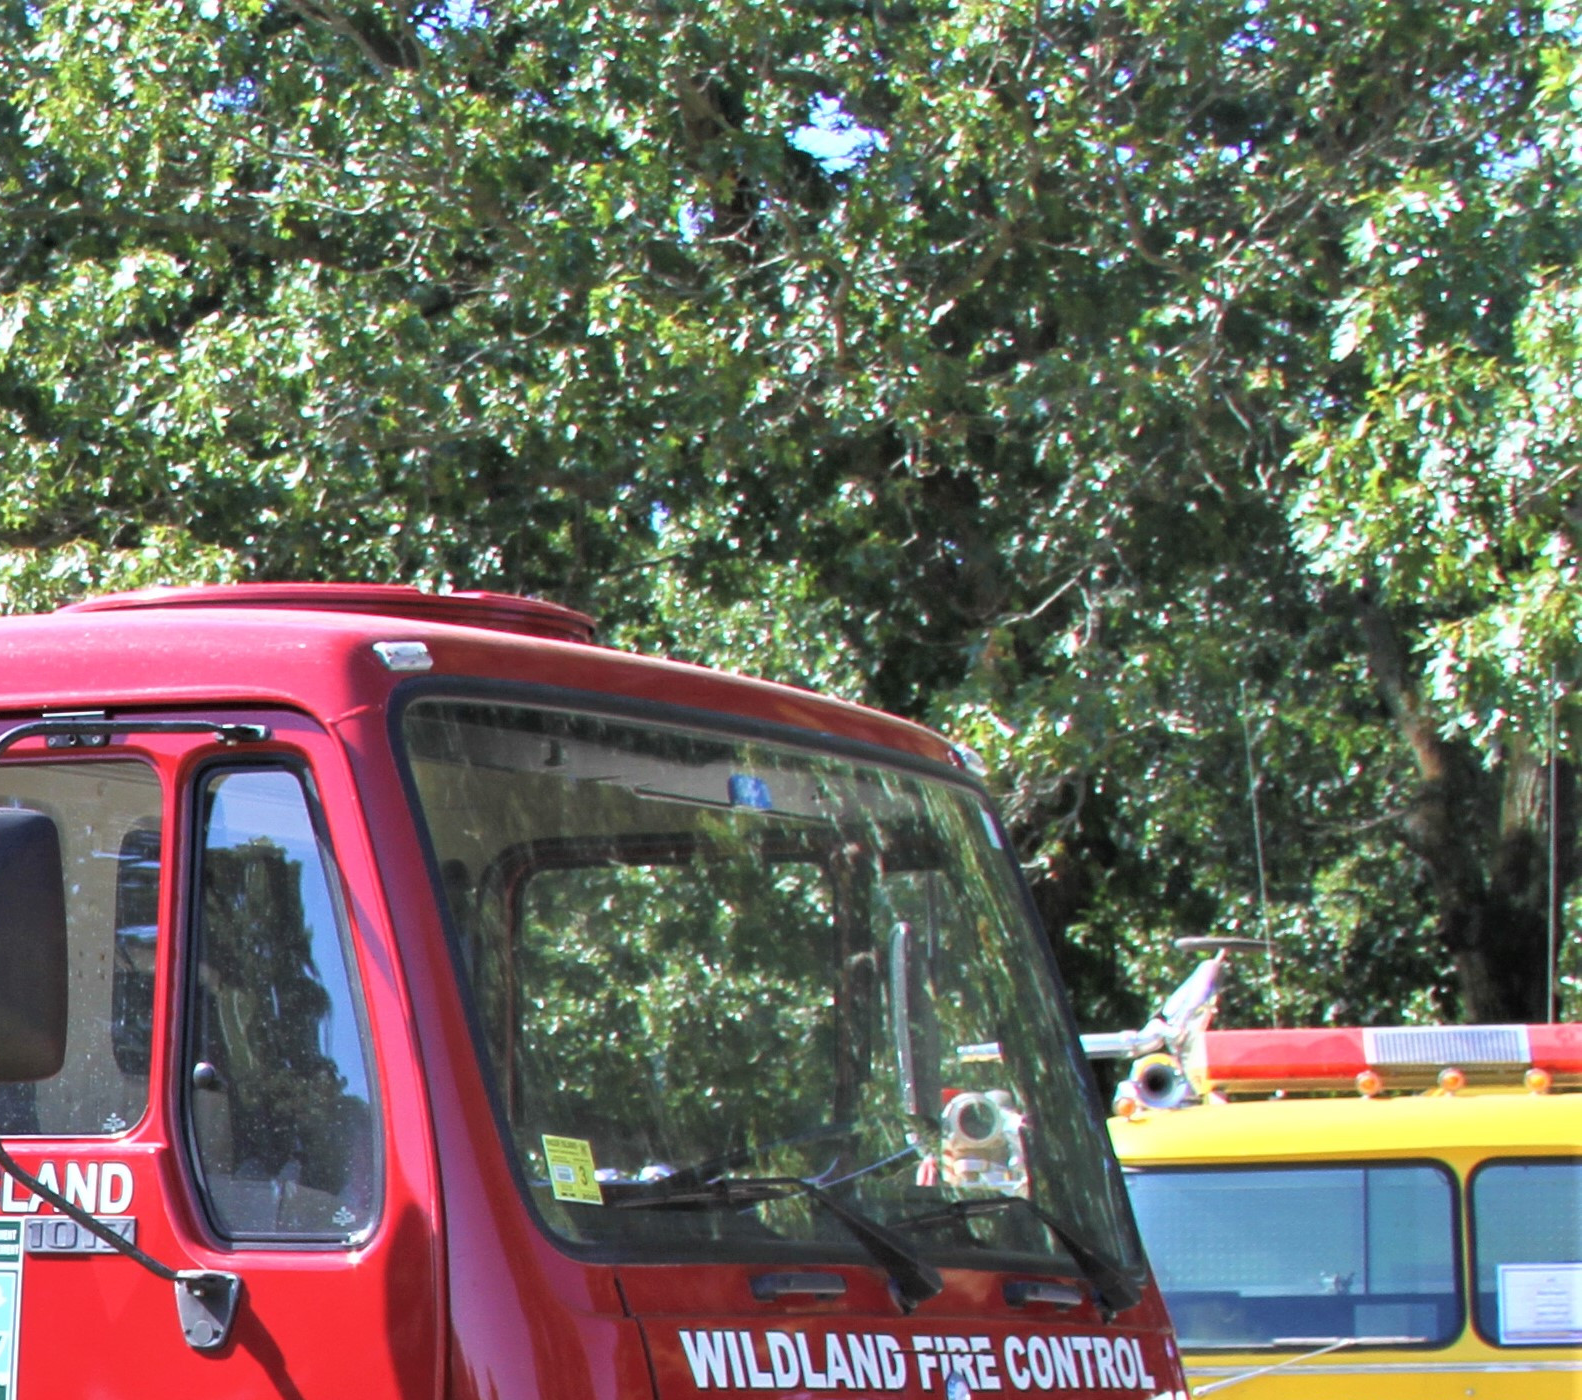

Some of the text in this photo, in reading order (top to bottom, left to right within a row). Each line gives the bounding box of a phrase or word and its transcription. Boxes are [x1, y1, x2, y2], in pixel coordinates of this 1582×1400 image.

[679, 1329, 1156, 1391] WILDLAND FIRE CONTROL
